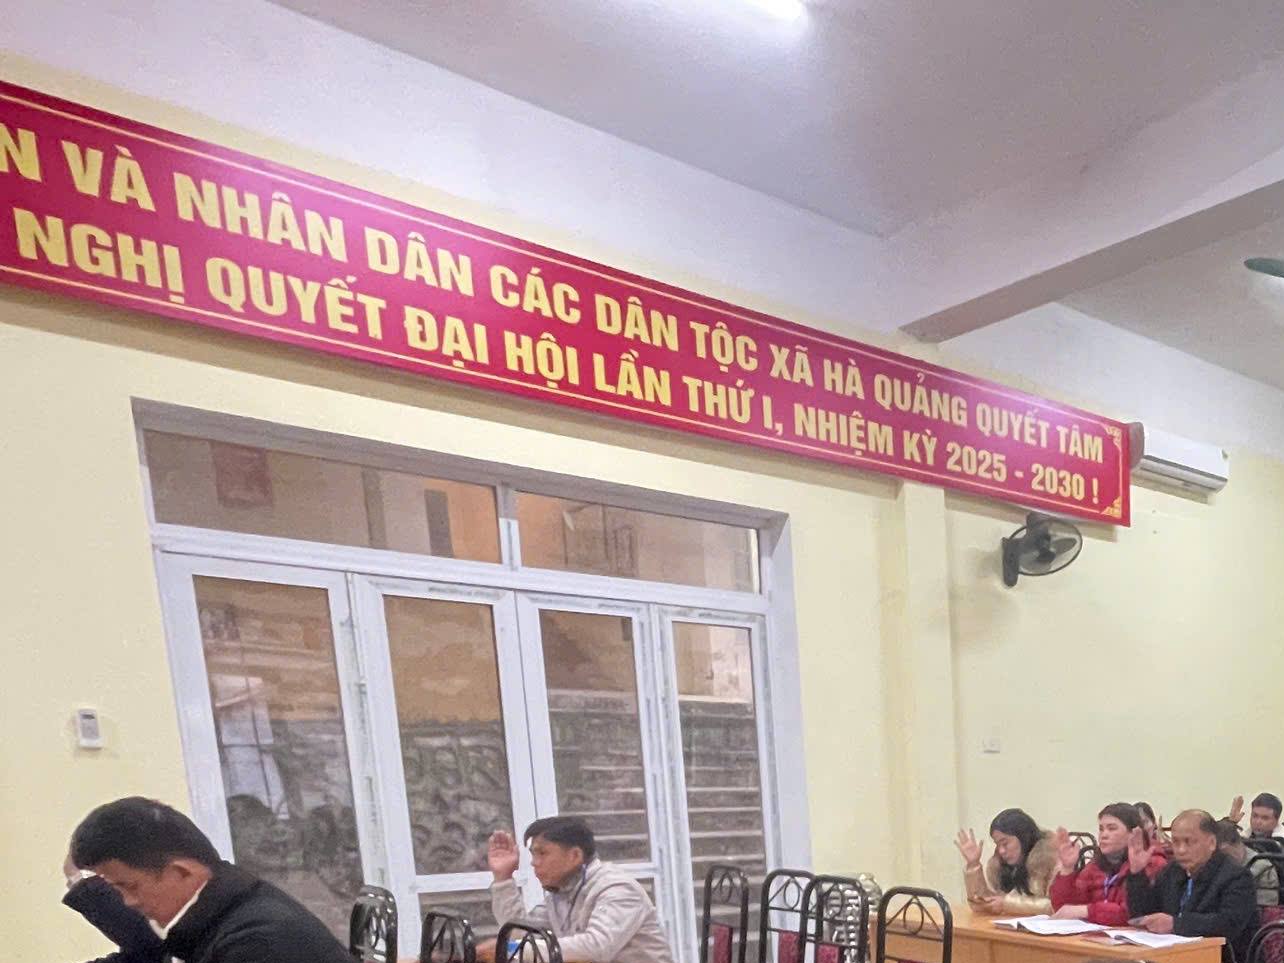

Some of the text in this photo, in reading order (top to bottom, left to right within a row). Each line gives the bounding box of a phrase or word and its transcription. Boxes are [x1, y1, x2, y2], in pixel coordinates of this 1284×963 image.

[0, 123, 1103, 464] N VÀ NHÂN DÂN CÁC DÂN TỘC XÃ HÀ QUẢNG QUYẾT TÂM
[14, 208, 184, 303] NGHỊ
[206, 258, 387, 341] QUYẾT
[404, 305, 490, 368] ĐẠI
[504, 331, 580, 389] HỘI
[593, 349, 672, 407] LẦN
[682, 376, 755, 424] THỨ
[763, 396, 783, 436] I,
[793, 404, 893, 458] NHIỆM
[903, 428, 938, 468] KỲ
[946, 442, 1007, 483] 2025
[1031, 463, 1084, 501] 2030
[1092, 478, 1099, 504] !
